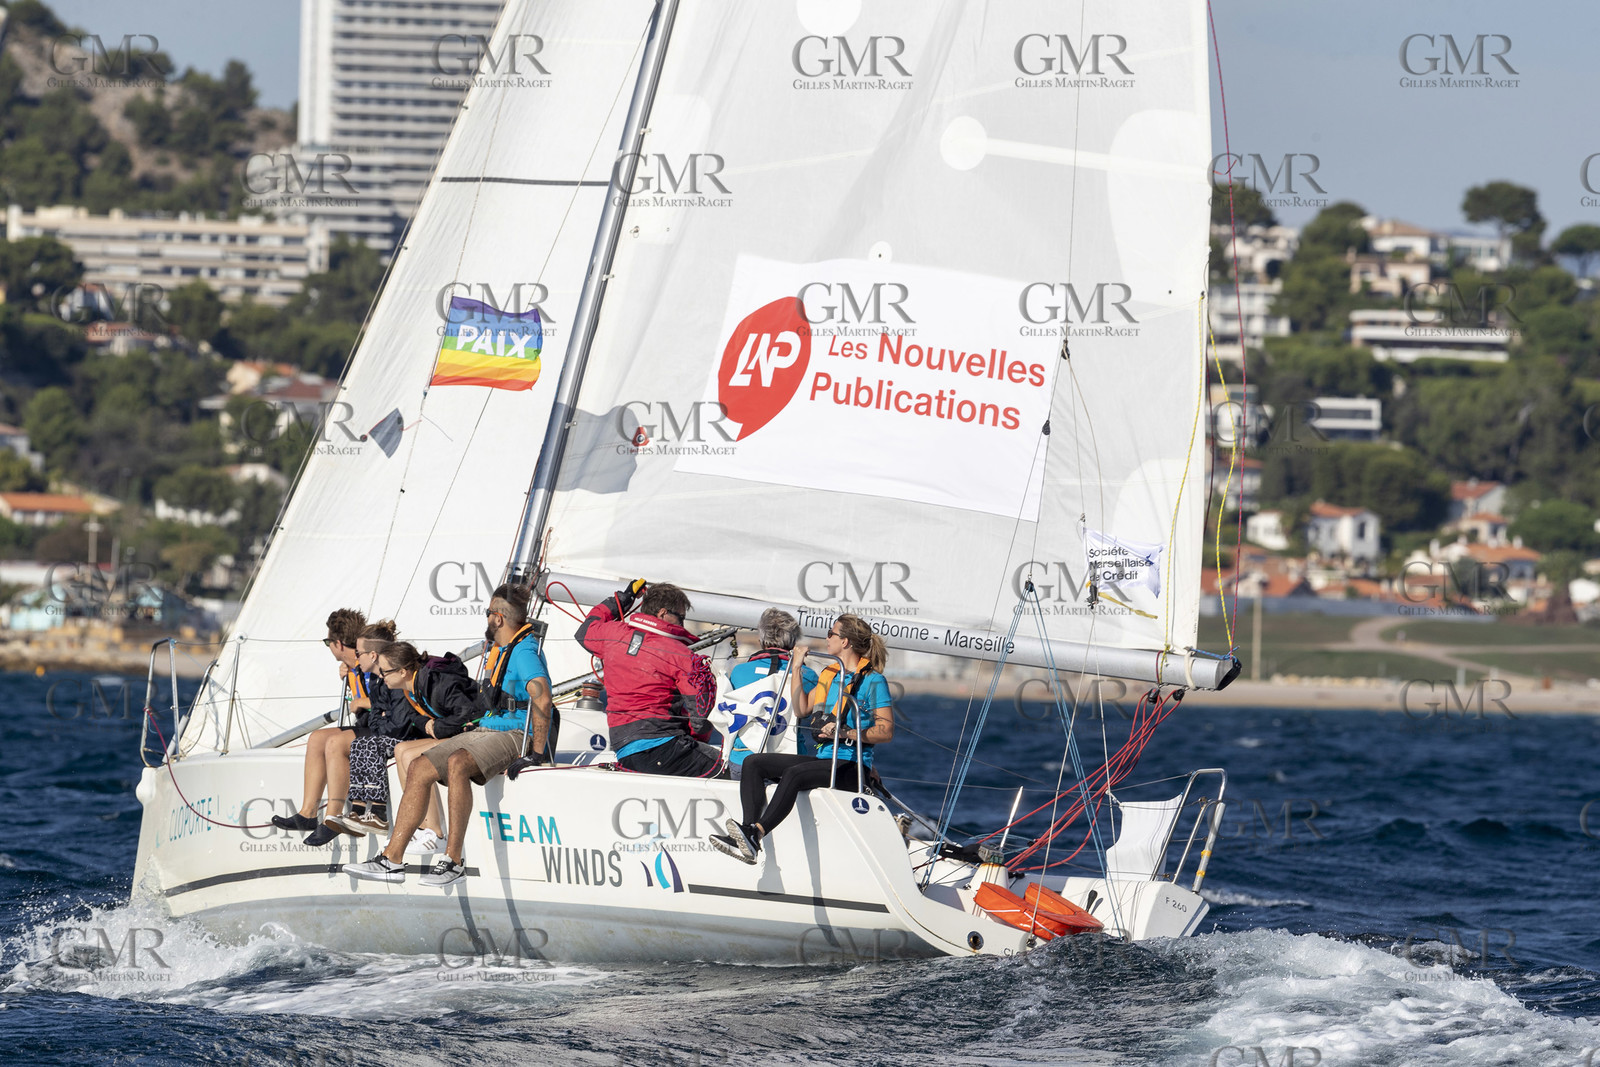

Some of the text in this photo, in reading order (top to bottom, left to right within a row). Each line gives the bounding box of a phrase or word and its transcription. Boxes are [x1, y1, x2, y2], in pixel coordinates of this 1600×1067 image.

[456, 324, 532, 359] PAIX
[828, 332, 1046, 387] Les Nouvelles
[809, 372, 1021, 430] Publications
[1102, 570, 1139, 581] Crédit
[797, 609, 838, 630] Trinit
[944, 629, 1015, 654] Marseille
[479, 811, 562, 845] TEAM
[541, 846, 623, 888] WINDS
